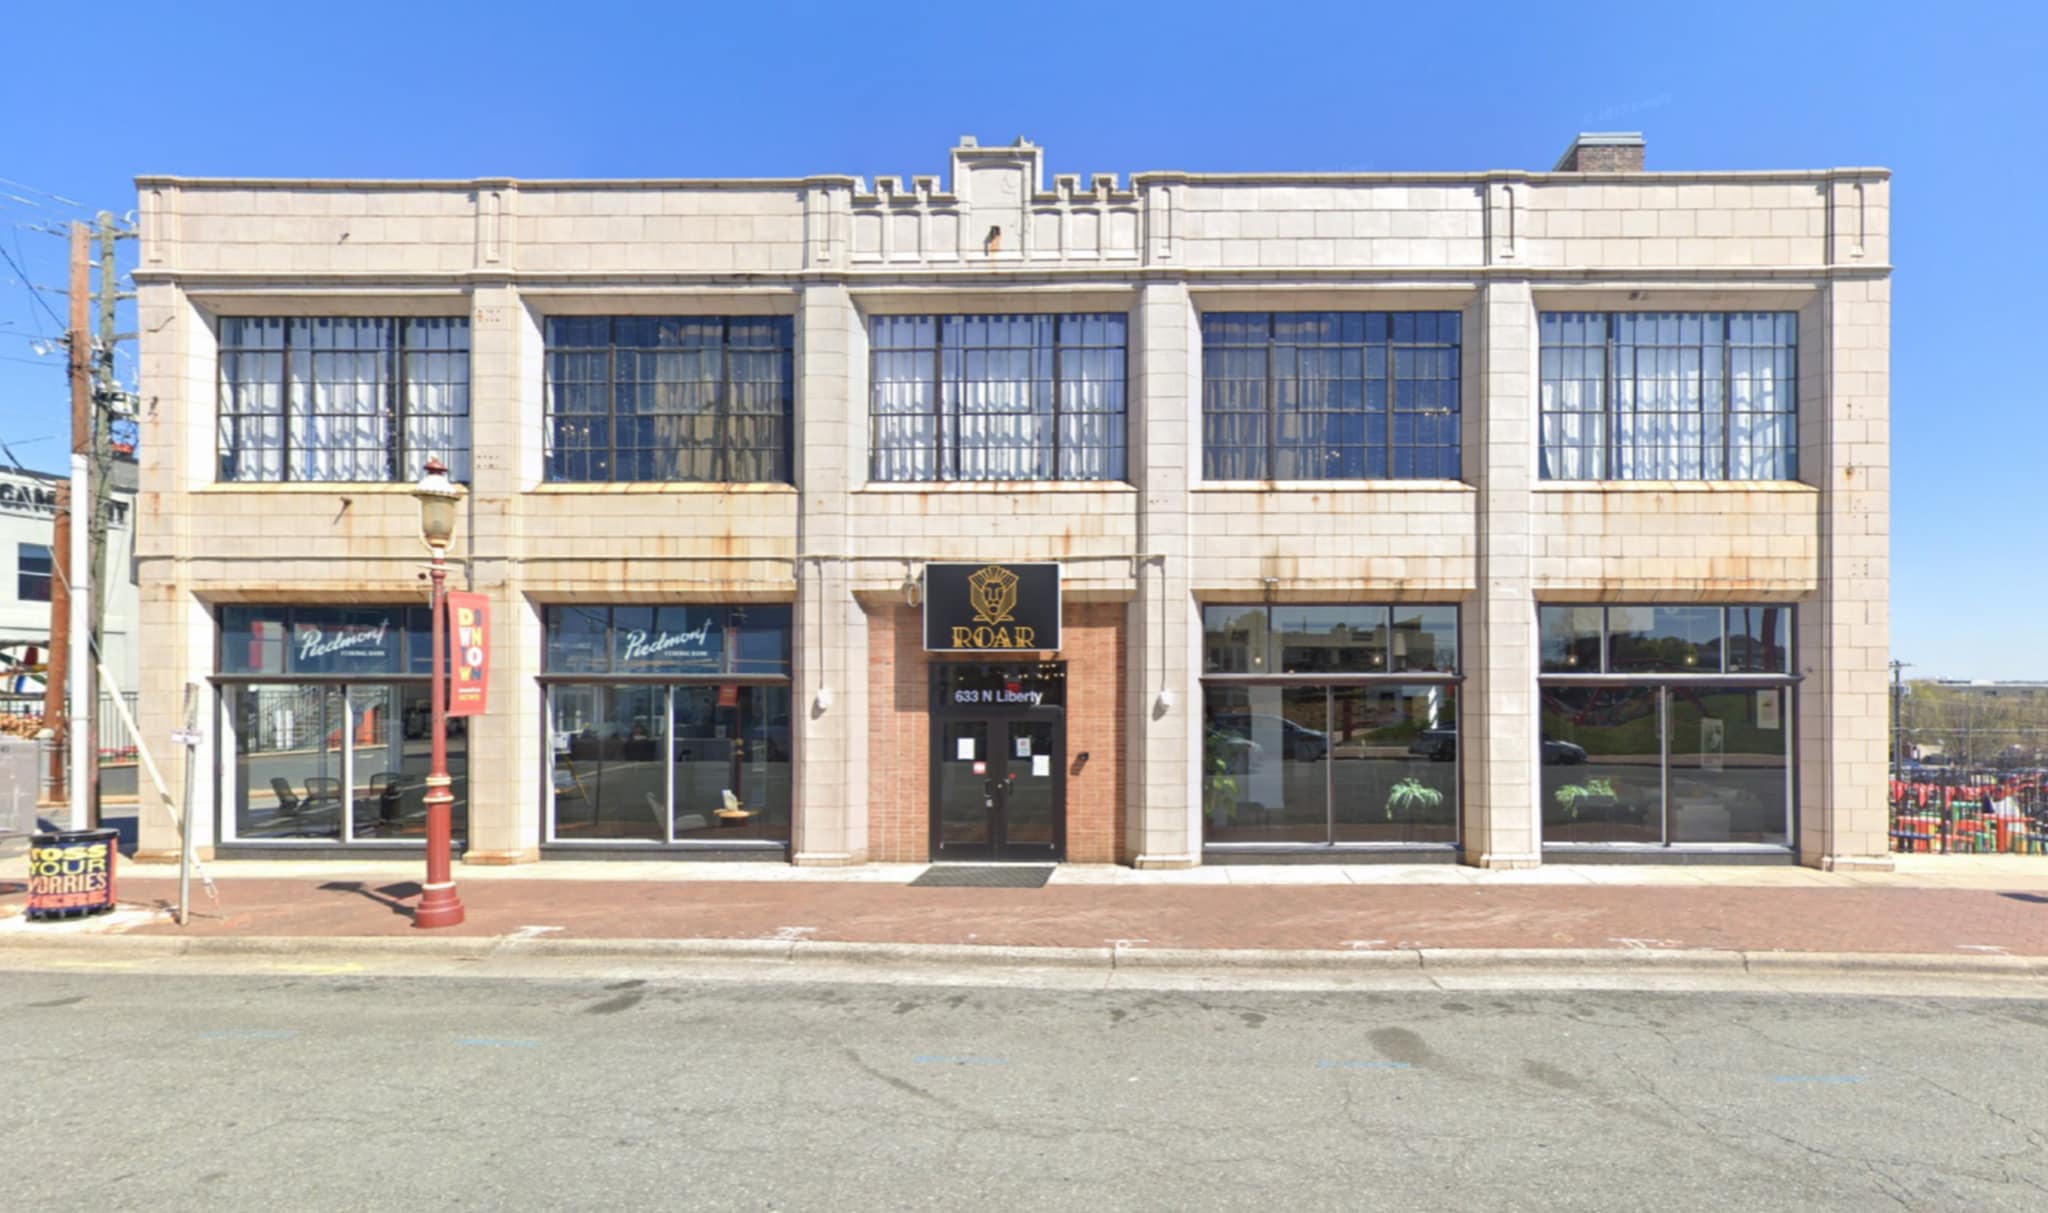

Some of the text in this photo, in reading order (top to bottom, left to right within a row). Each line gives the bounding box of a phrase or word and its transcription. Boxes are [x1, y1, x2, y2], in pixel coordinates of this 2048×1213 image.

[300, 618, 389, 660] Piedmont
[624, 618, 712, 660] Piedmont
[952, 626, 1035, 648] ROAR
[954, 690, 1043, 706] 633 N Liberty
[29, 859, 106, 876] YOUR
